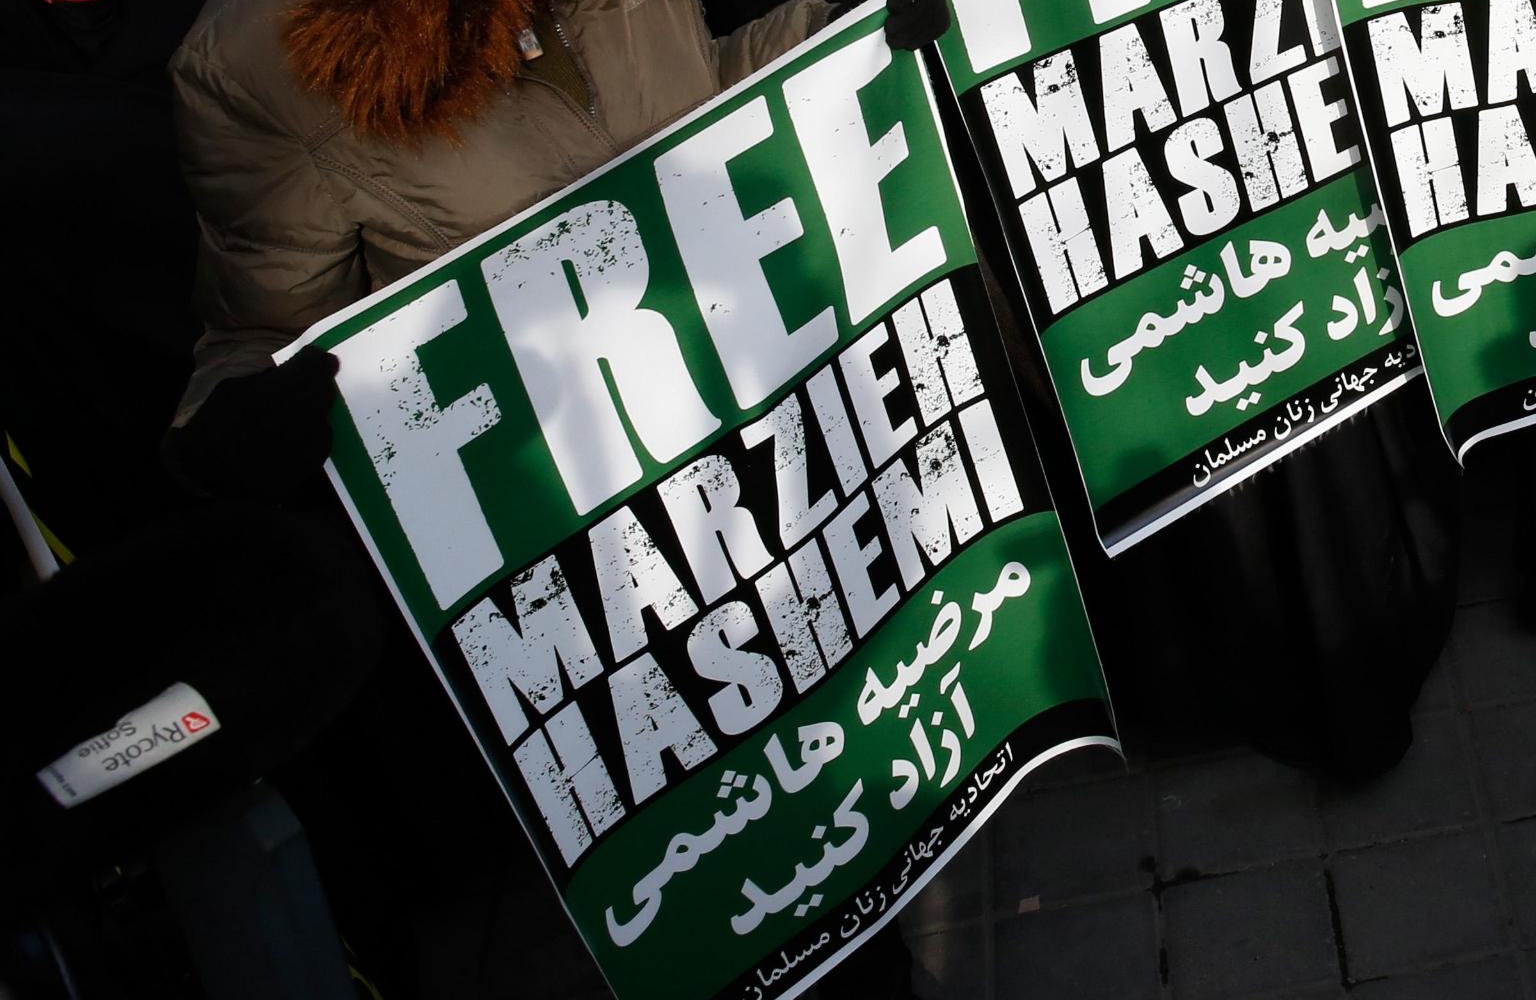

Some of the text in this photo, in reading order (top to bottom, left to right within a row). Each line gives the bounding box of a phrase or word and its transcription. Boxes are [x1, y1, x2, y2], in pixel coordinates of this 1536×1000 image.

[1018, 56, 1362, 315] HASHE
[328, 28, 946, 611] FREE
[1080, 239, 1292, 397] هاشمی
[1185, 266, 1405, 417] زاد کنید
[1274, 397, 1315, 440] زنان
[451, 278, 984, 746] MARZIEH
[1192, 427, 1267, 487] مسلمان
[511, 398, 1023, 868] HASHEMI
[77, 720, 137, 760] Softie
[102, 721, 186, 773] Rycote
[605, 561, 1031, 948] مرضیه هاشمی
[730, 661, 975, 936] آزاد کنید
